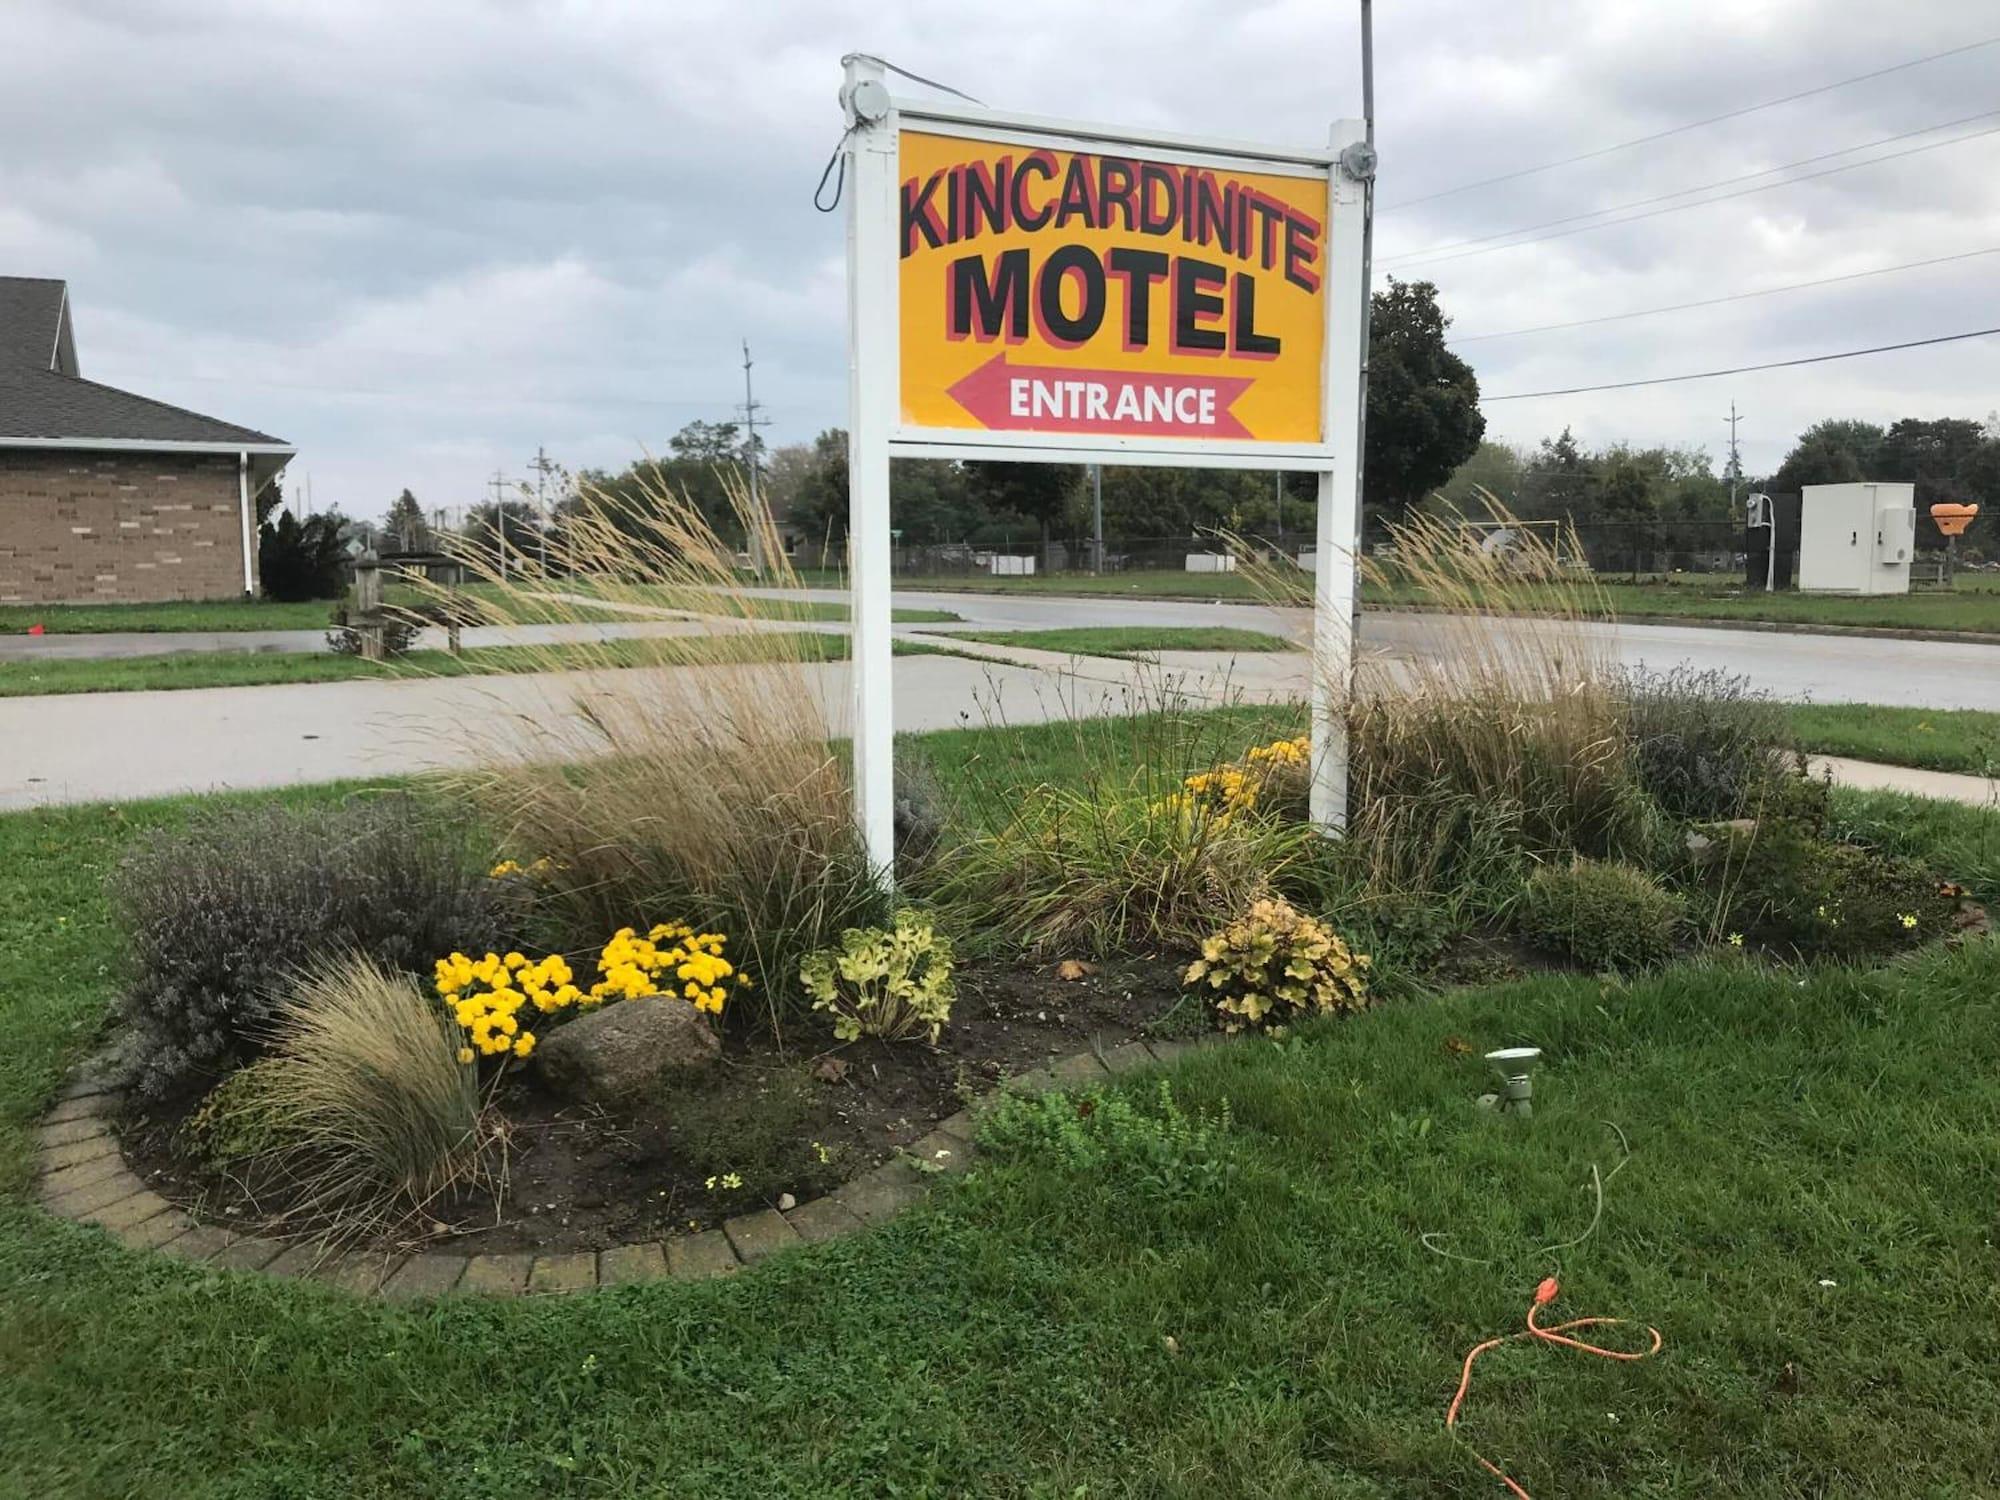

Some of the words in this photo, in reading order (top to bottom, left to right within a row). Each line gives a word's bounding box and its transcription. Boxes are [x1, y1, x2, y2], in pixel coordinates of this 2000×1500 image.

[900, 149, 1321, 295] KINCARDINITE
[946, 244, 1281, 361] MOTEL
[1010, 378, 1216, 425] ENTRANCE
